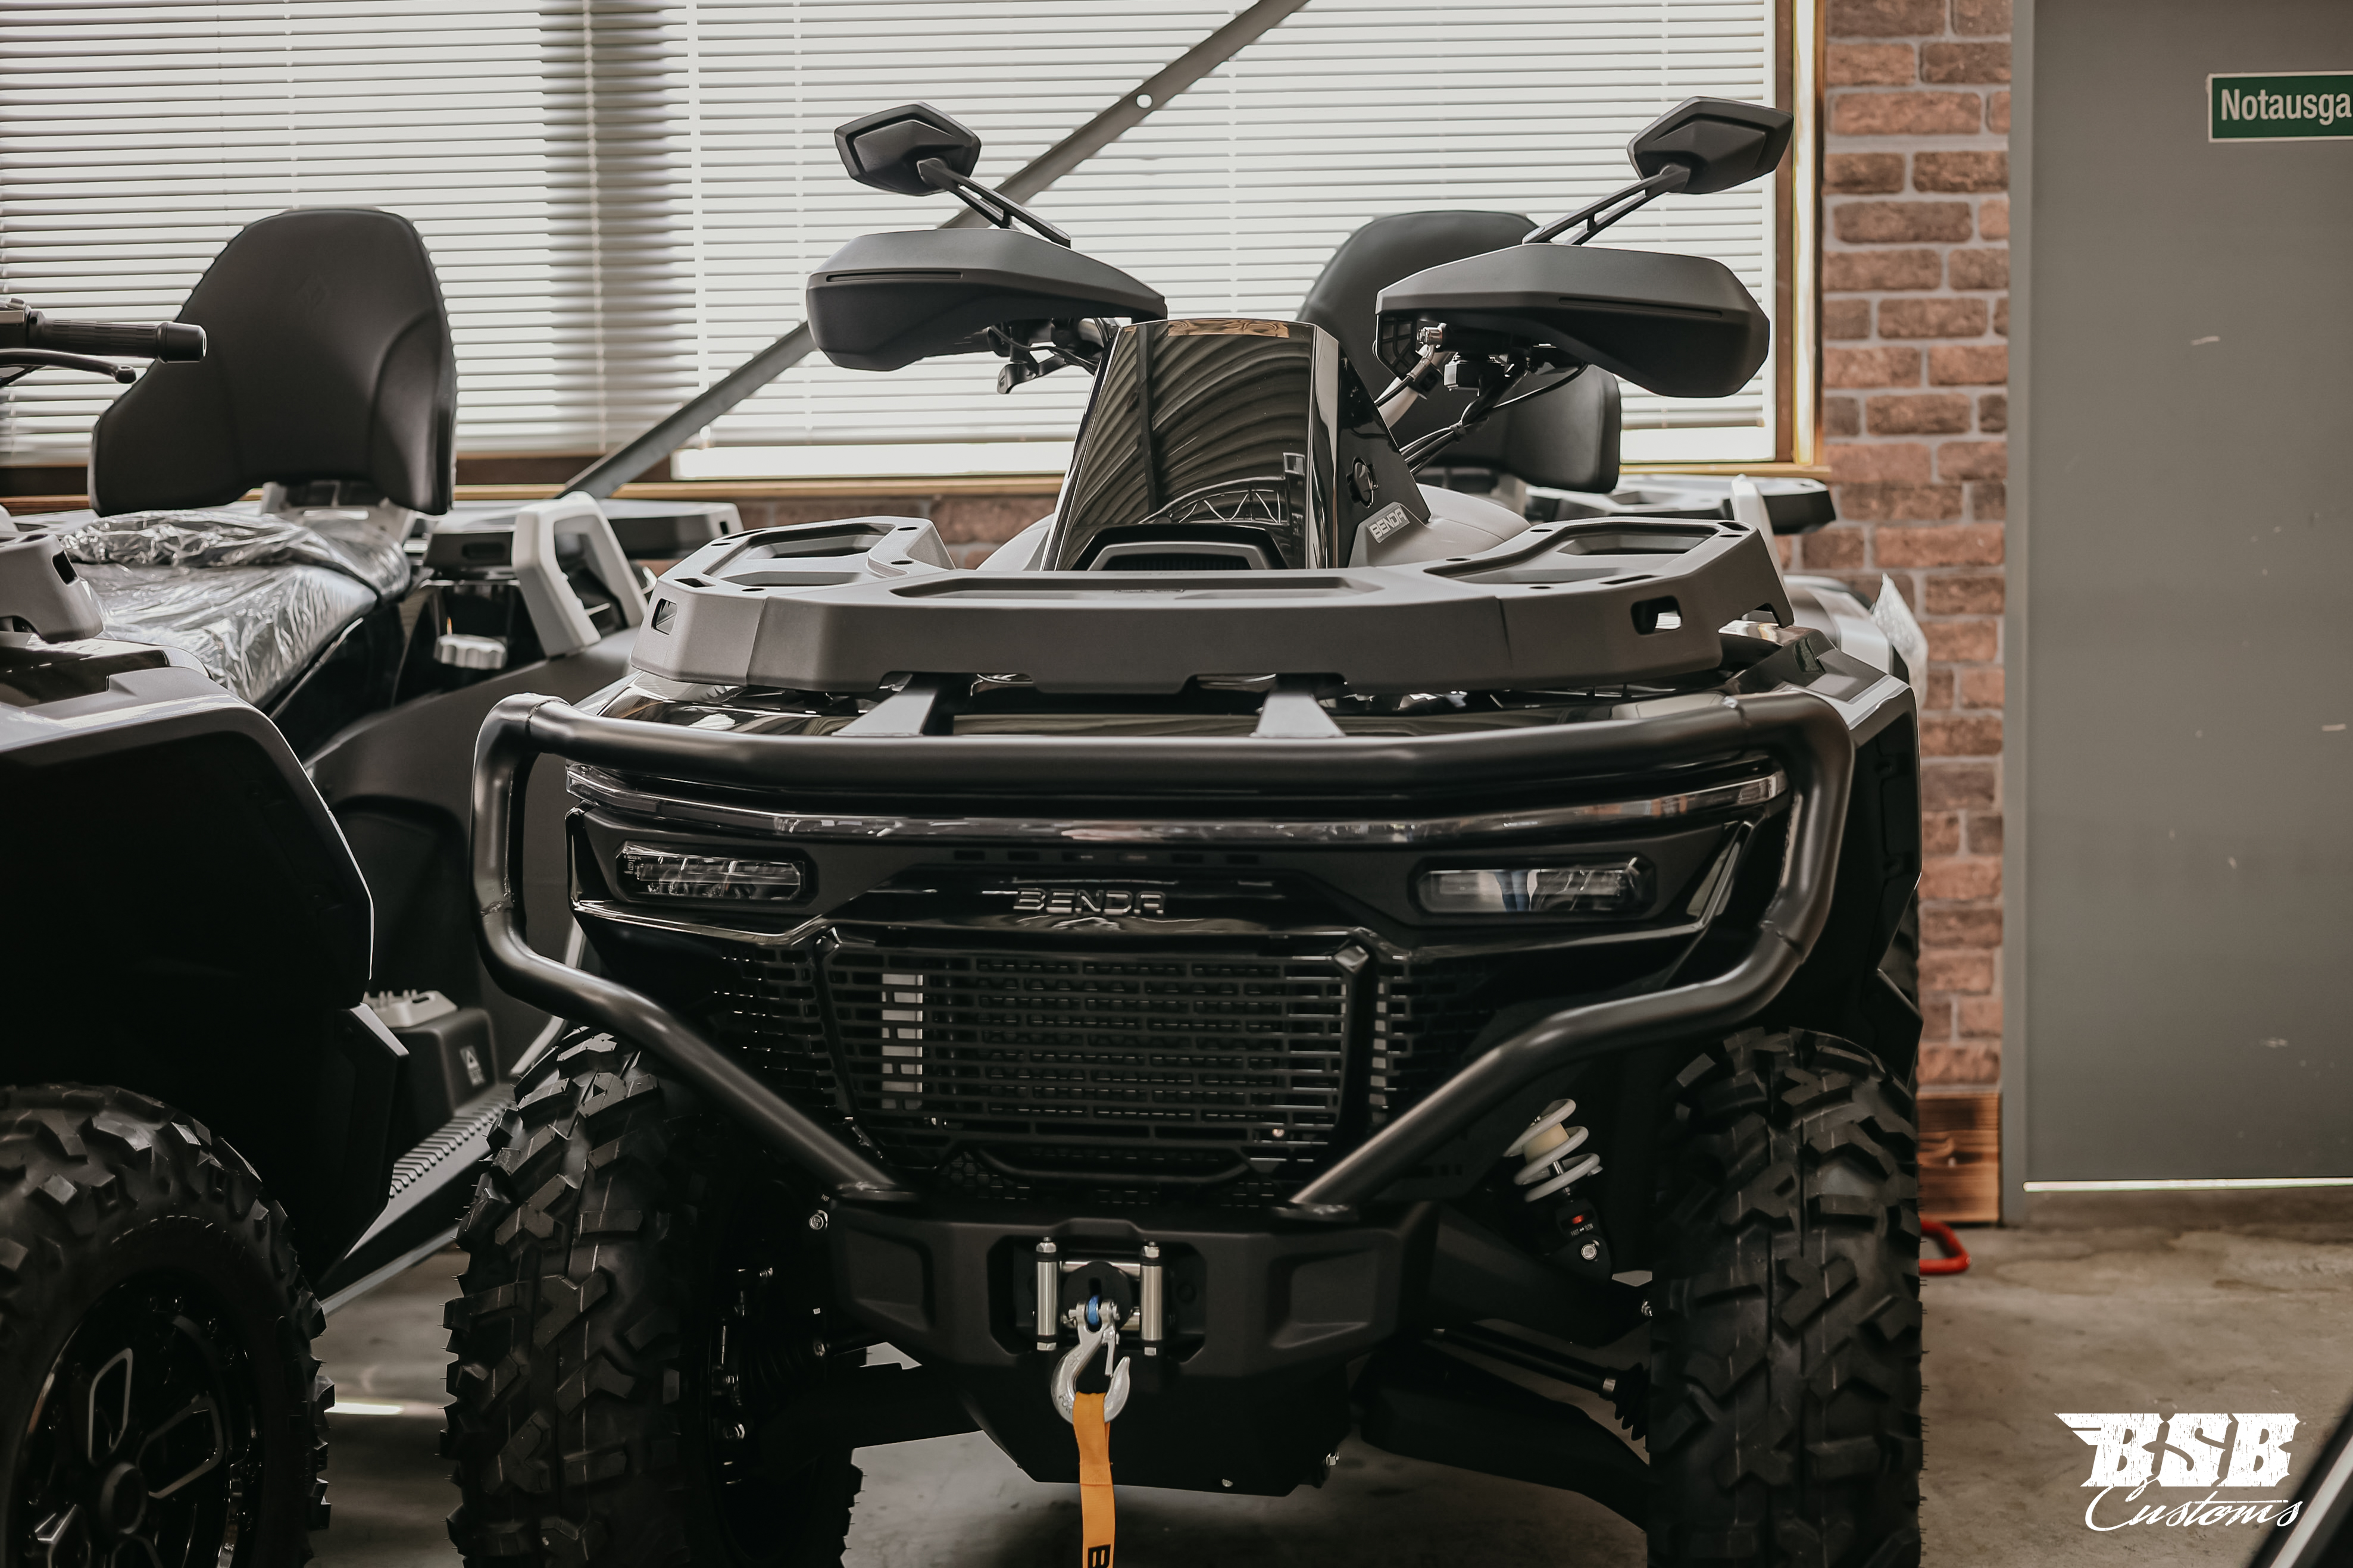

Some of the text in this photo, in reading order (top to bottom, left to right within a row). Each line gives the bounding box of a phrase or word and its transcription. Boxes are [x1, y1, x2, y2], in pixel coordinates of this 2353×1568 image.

[2221, 89, 2352, 126] Notausga
[1369, 508, 1407, 539] BENDA
[1013, 887, 1166, 915] BENDA
[1570, 1223, 1593, 1237] FAST SLOW
